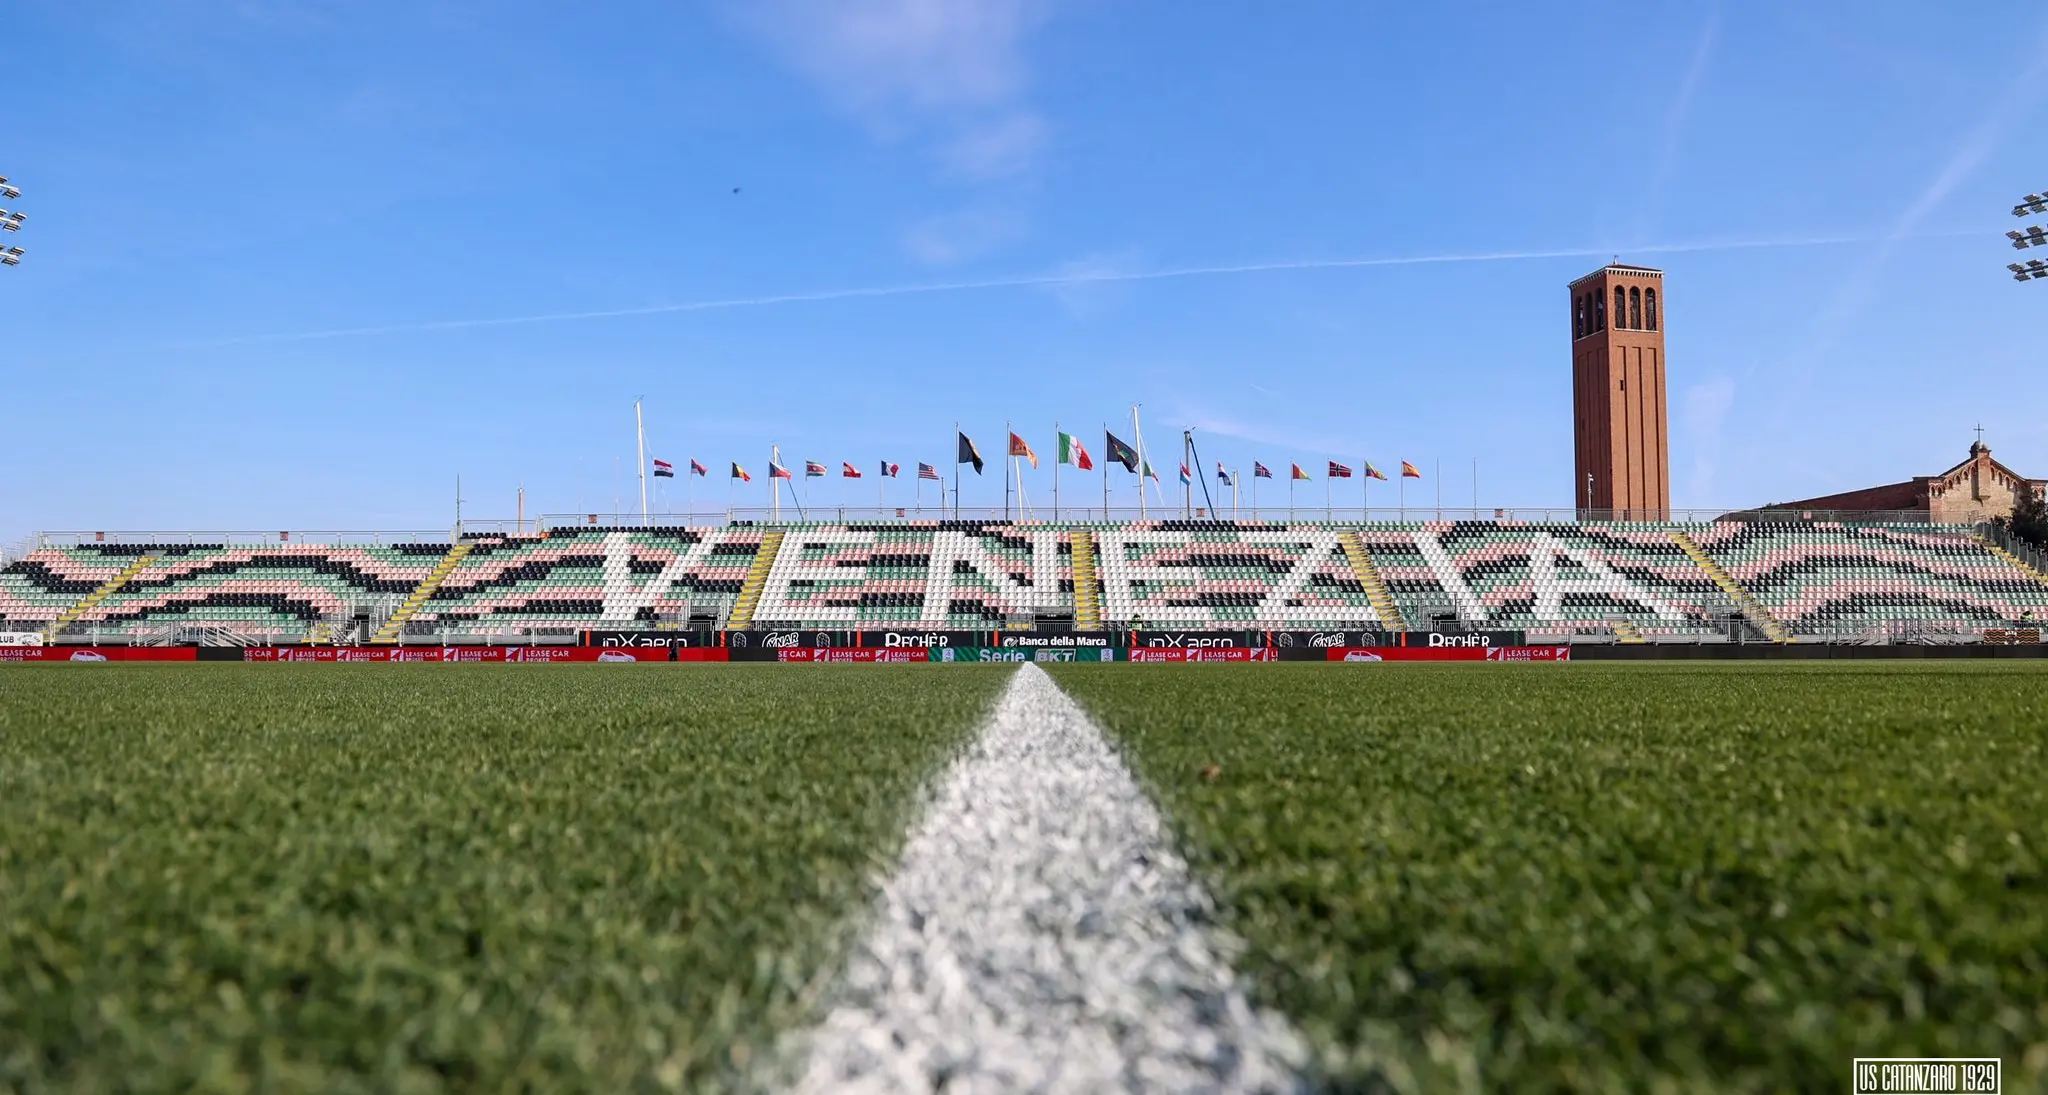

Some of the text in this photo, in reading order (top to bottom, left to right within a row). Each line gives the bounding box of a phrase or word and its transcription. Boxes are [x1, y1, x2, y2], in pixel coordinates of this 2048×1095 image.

[600, 530, 1690, 622] VENEZIA
[1019, 636, 1107, 646] Banca della Marca
[0, 649, 42, 657] LEASE CAR
[789, 650, 807, 658] CAR
[831, 650, 870, 658] LEASE CAR
[979, 649, 1026, 662] Serie
[1506, 649, 1550, 657] LEASE CAR
